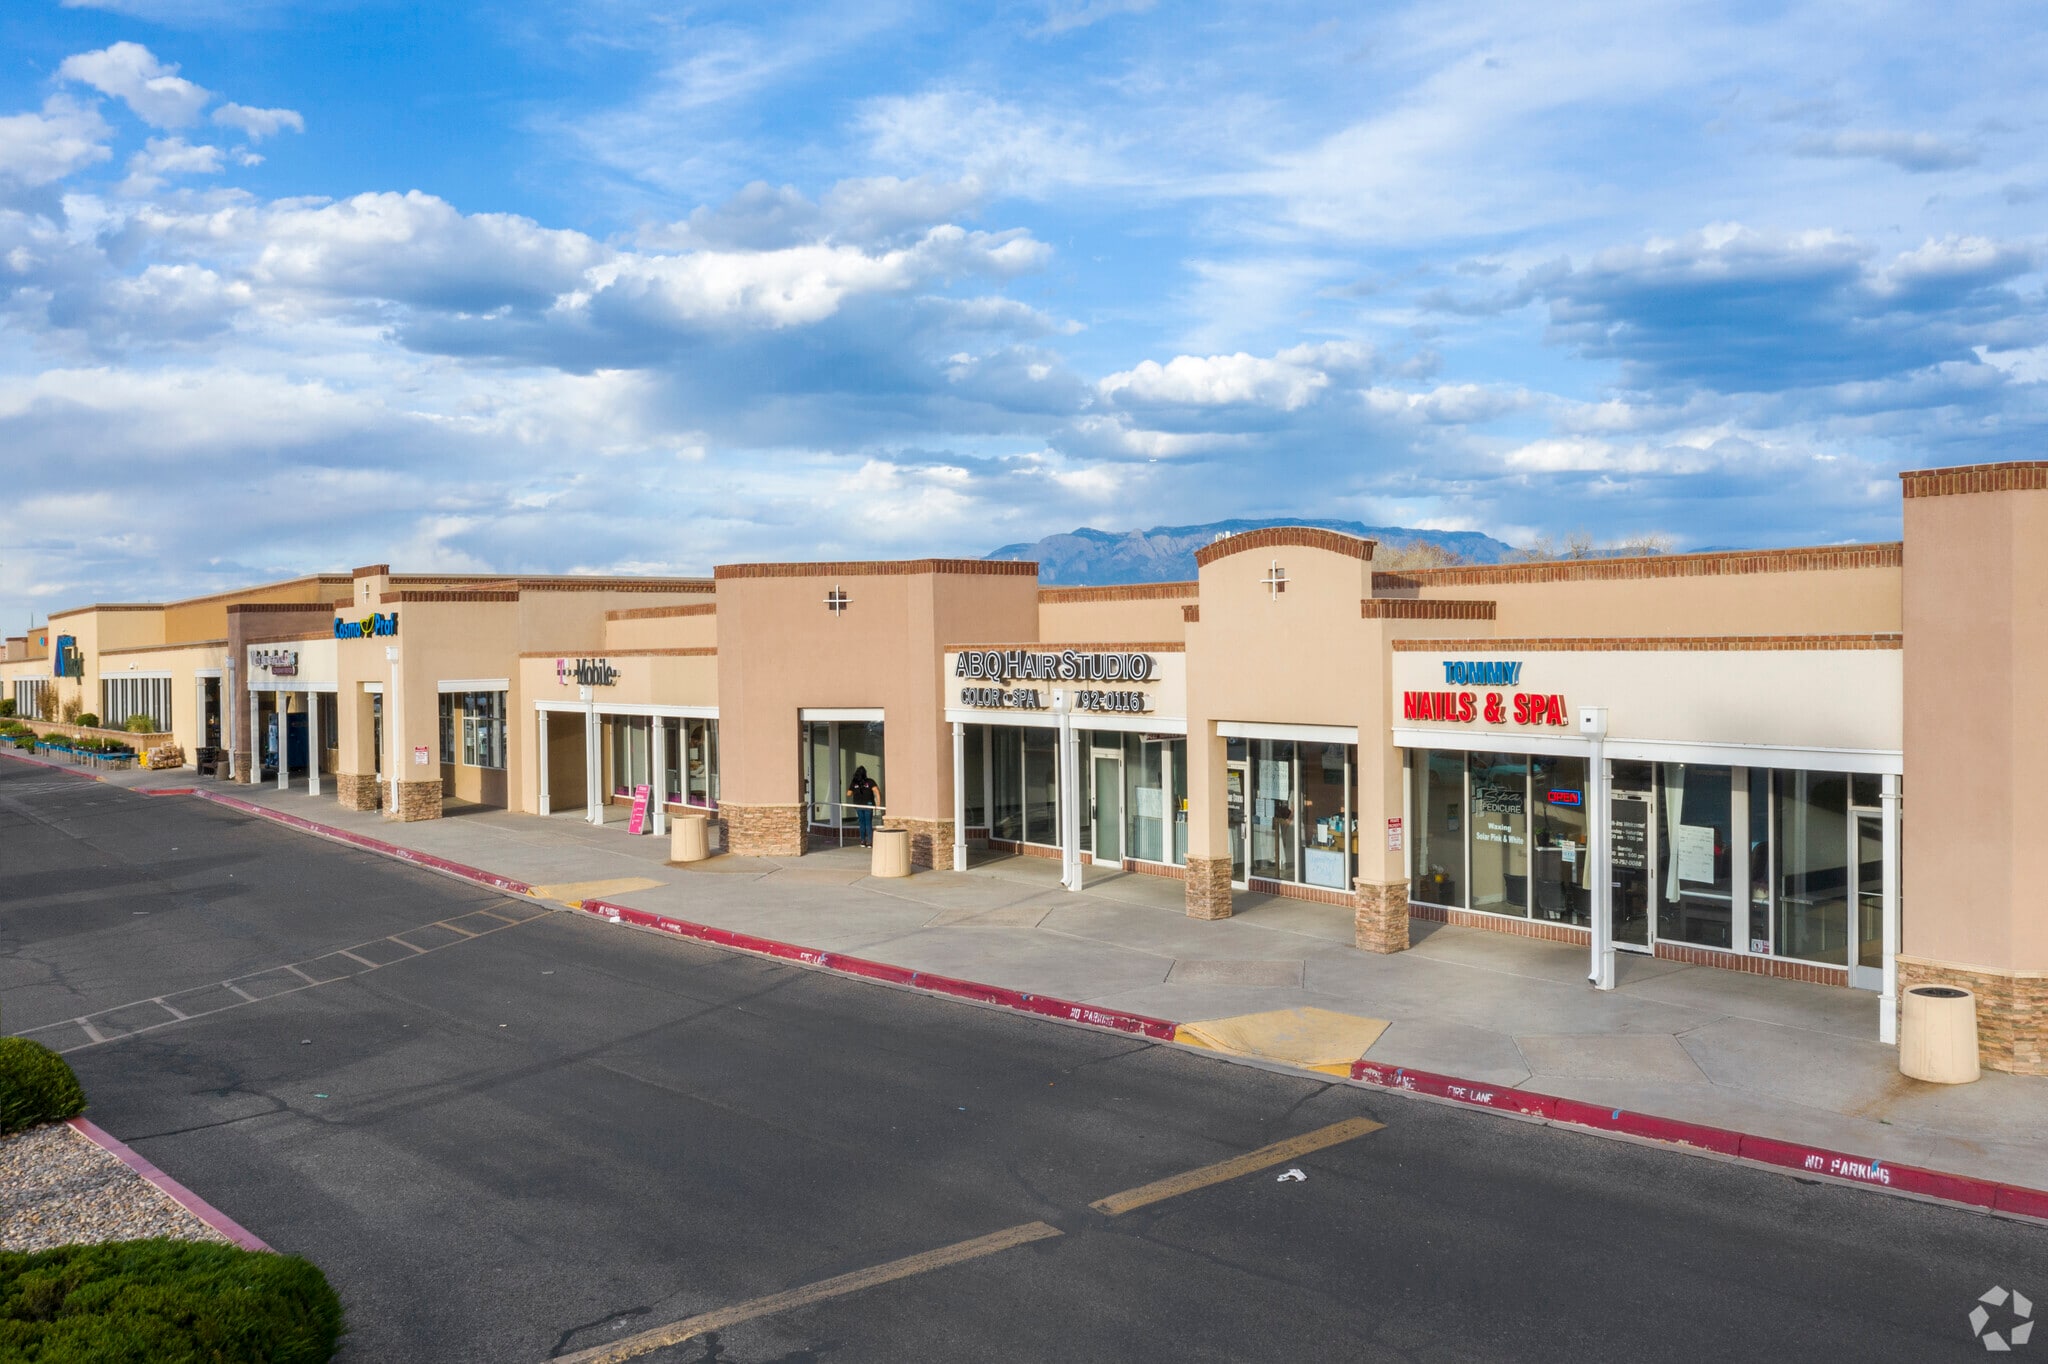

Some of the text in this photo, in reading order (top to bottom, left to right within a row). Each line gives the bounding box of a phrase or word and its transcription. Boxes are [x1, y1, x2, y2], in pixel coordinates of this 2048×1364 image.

[334, 612, 396, 639] Cosmo Prof
[956, 651, 1000, 683] ABQ
[1443, 661, 1520, 685] TOMMY
[961, 688, 1036, 708] COLOR SPA
[1074, 690, 1140, 712] 792-0116
[1404, 691, 1566, 725] NAILS & SPA
[1482, 803, 1521, 814] PEDICURE
[1547, 791, 1579, 803] OPEN
[1487, 822, 1512, 833] Waxing
[1829, 1158, 1890, 1185] PARKING
